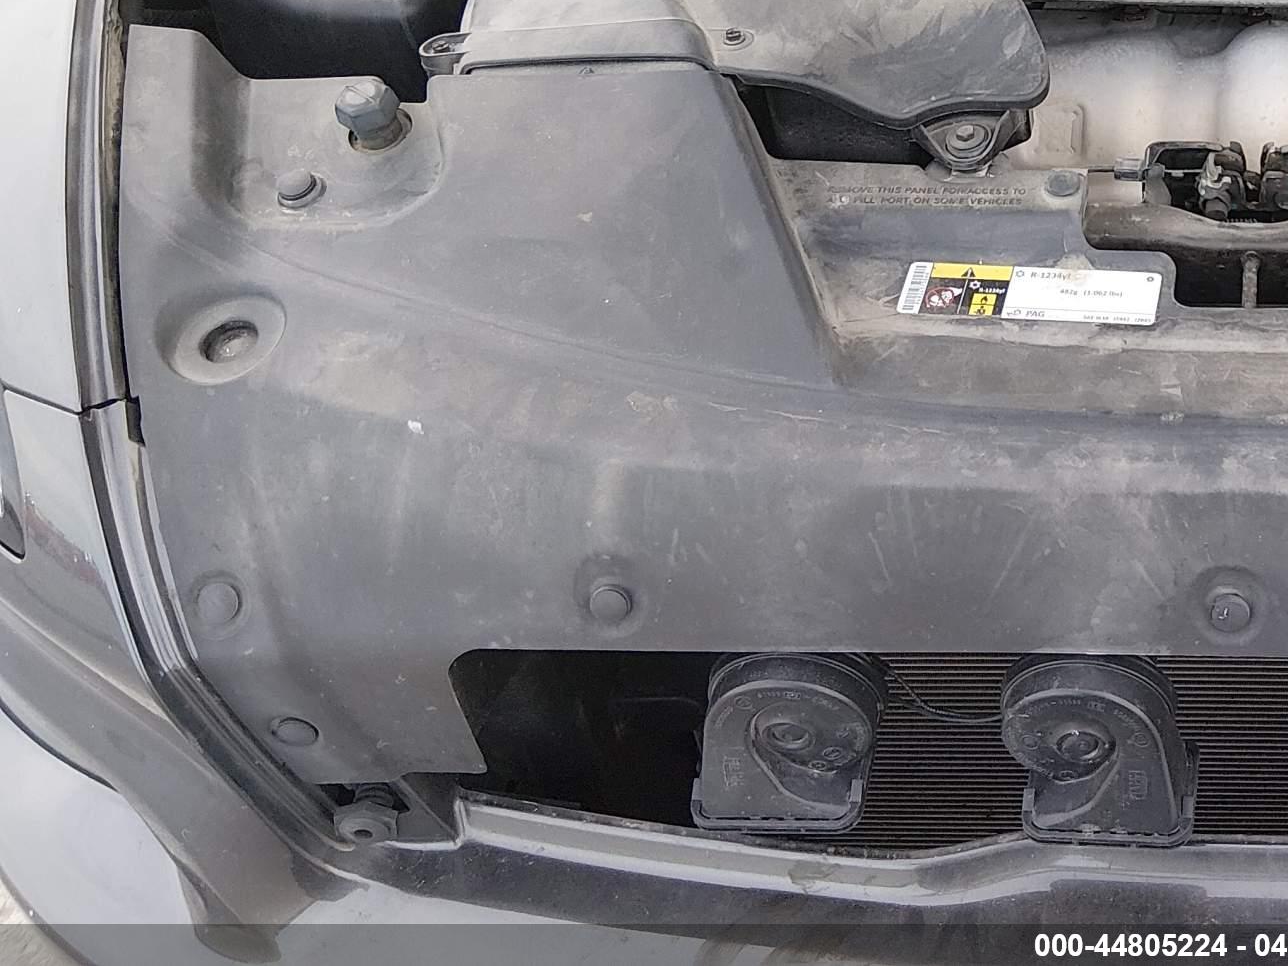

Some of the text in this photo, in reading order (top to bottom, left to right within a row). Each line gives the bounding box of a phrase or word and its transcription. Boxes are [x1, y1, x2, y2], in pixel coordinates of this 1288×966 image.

[826, 186, 874, 195] RMOVE
[878, 186, 901, 195] THIS
[904, 186, 938, 195] PANEL
[966, 186, 1010, 195] ACCESS
[1012, 187, 1027, 196] TO
[912, 196, 931, 205] ON
[933, 196, 965, 205] SOME
[969, 197, 1023, 206] VEHICLES
[1025, 309, 1046, 318] PAG
